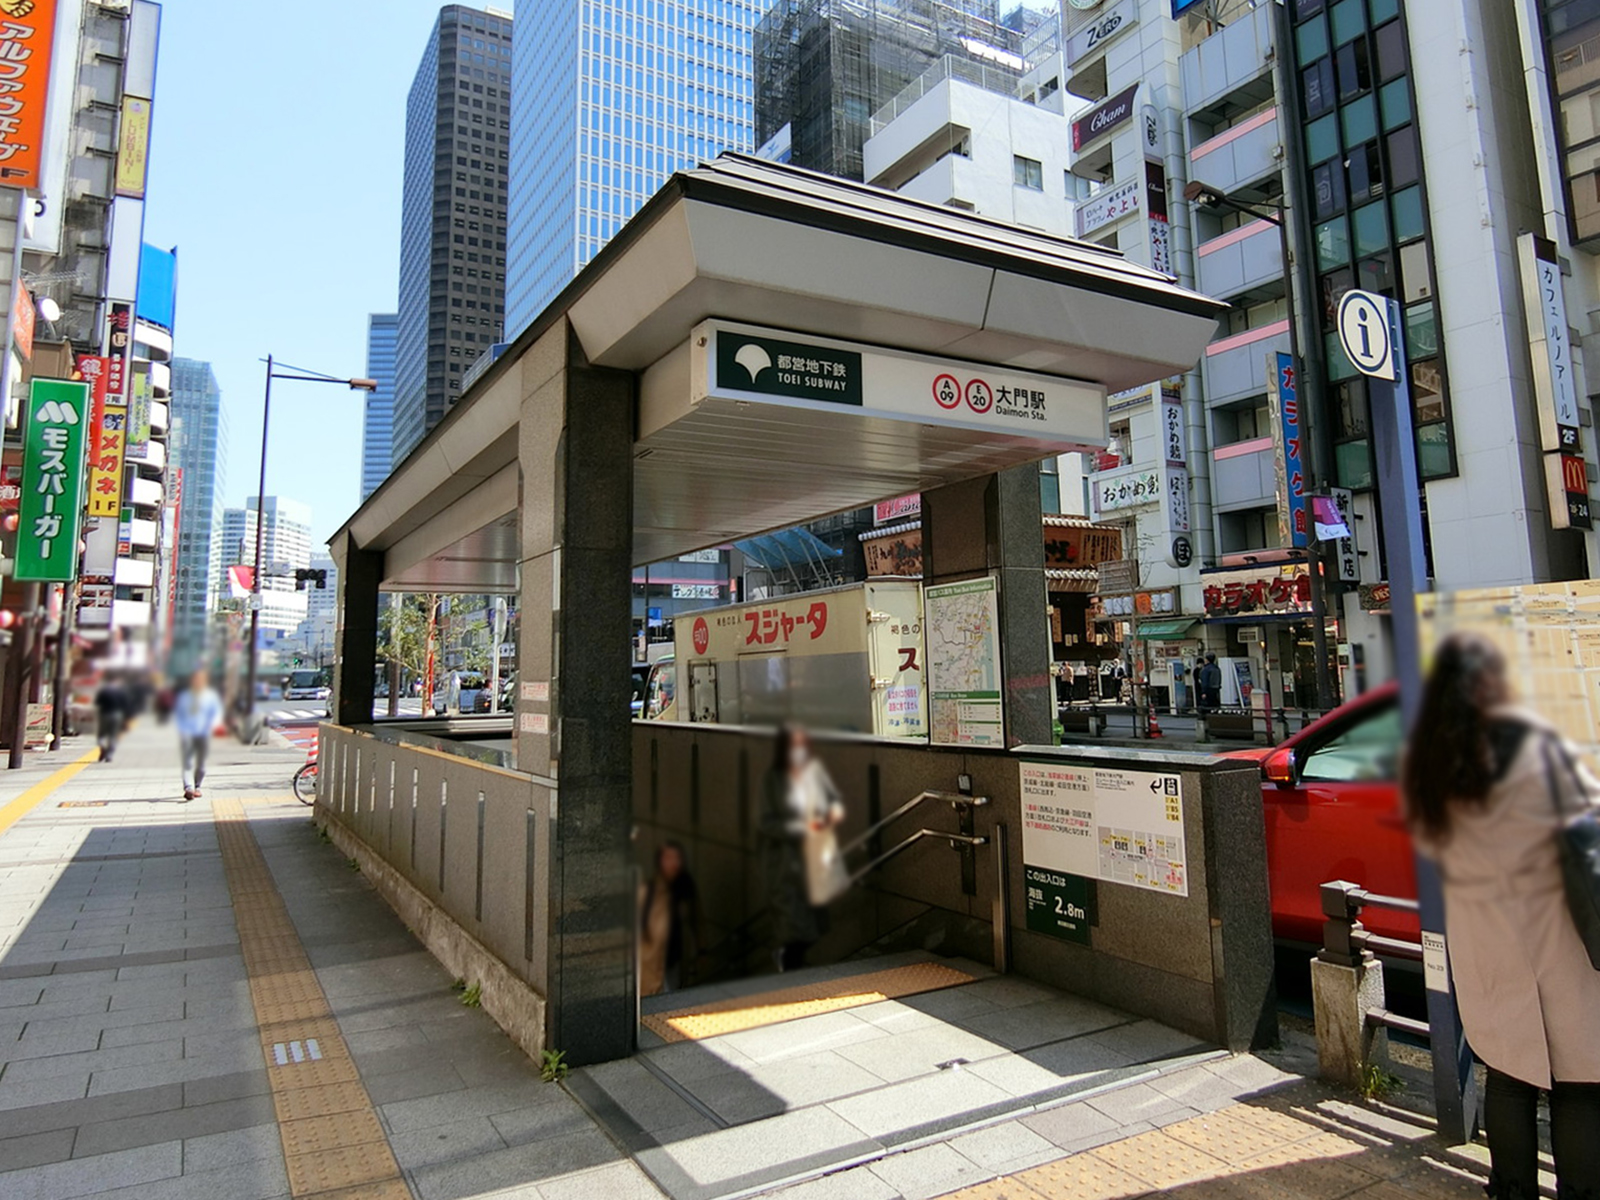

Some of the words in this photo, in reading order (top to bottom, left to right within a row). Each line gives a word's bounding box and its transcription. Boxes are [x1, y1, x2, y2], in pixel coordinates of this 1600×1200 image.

[0, 21, 36, 161] アルファウェブ
[778, 354, 847, 377] 都営地下鉄
[778, 372, 800, 384] TOEI
[804, 376, 847, 391] SUBWAY
[943, 380, 951, 390] A
[976, 385, 982, 394] E
[940, 390, 954, 402] 09
[972, 395, 986, 407] 20
[996, 386, 1046, 410] 大門駅
[996, 405, 1030, 419] Daimon
[1032, 410, 1048, 421] Sta.
[1562, 428, 1576, 444] 2F
[96, 434, 120, 495] メガネ
[34, 428, 68, 559] モスバーガー
[1336, 492, 1356, 578] 新飯店
[745, 601, 828, 646] スジャータ
[1026, 870, 1066, 888] この出入口は
[1054, 896, 1085, 920] 2.8m
